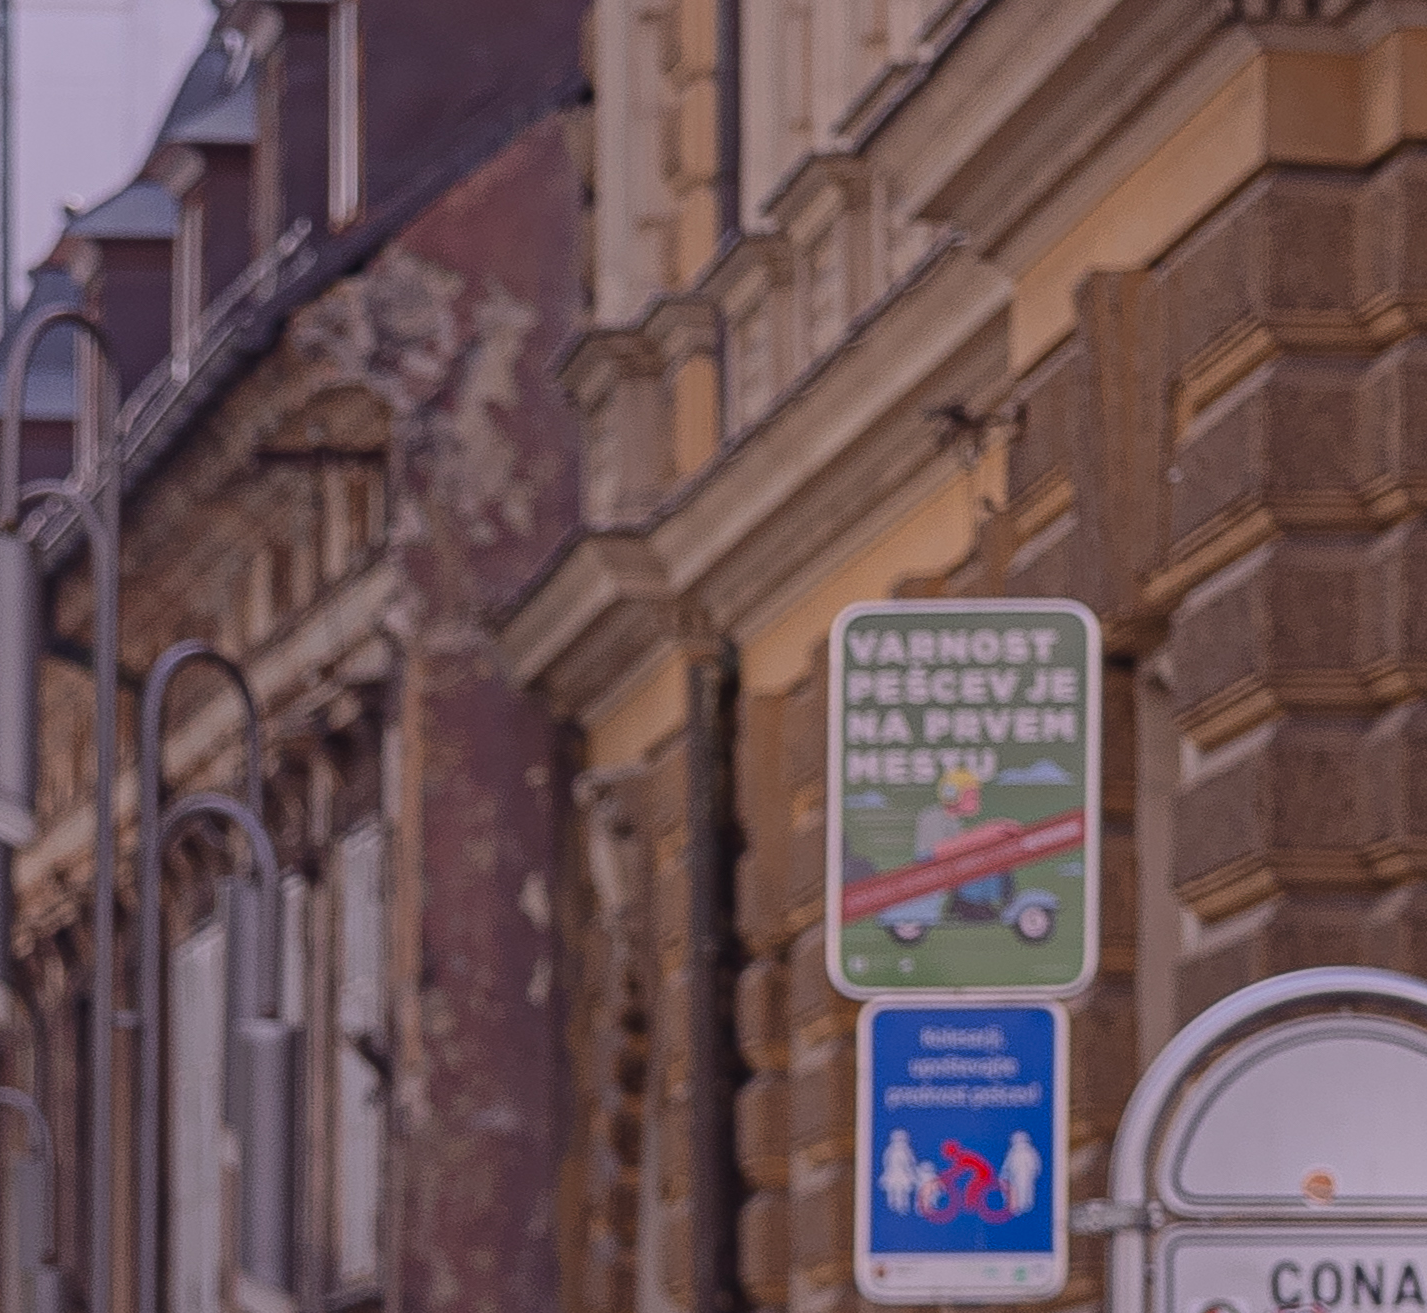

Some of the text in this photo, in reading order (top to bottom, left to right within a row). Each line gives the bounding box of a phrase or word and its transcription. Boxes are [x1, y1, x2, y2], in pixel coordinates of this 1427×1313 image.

[847, 628, 1059, 664] VARNOST
[1026, 668, 1077, 704] JE
[848, 708, 1076, 744] NA PRVEM
[848, 748, 998, 785] MESTU
[1271, 1259, 1427, 1306] CONA
